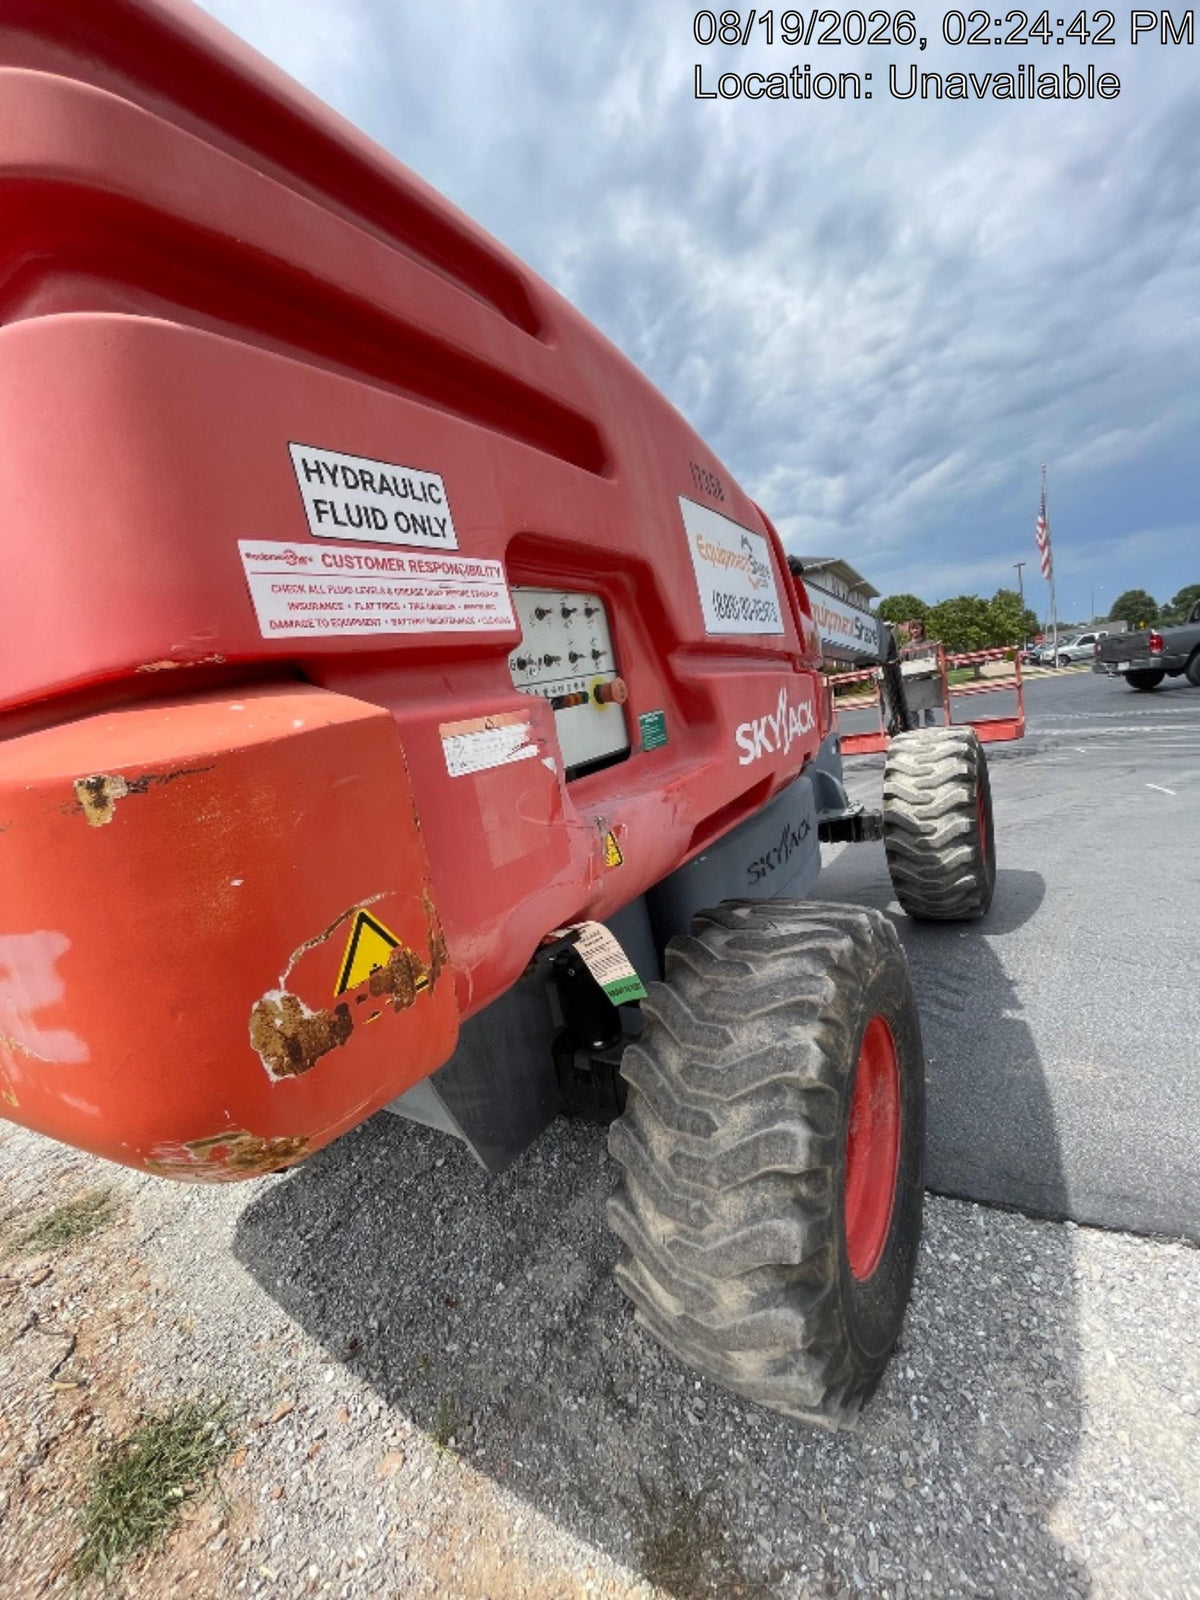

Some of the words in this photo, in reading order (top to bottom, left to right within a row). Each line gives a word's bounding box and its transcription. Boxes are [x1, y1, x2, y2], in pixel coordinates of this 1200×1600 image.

[301, 458, 442, 504] HYDRAULIC
[312, 499, 388, 531] FLUID
[394, 511, 447, 539] ONLY
[321, 553, 406, 573] CUSTOMER
[409, 559, 501, 578] RESPONSIBILITY
[269, 619, 315, 630] DAMAGE
[735, 687, 815, 765] SKYJACK
[747, 814, 812, 886] SKYJACK
